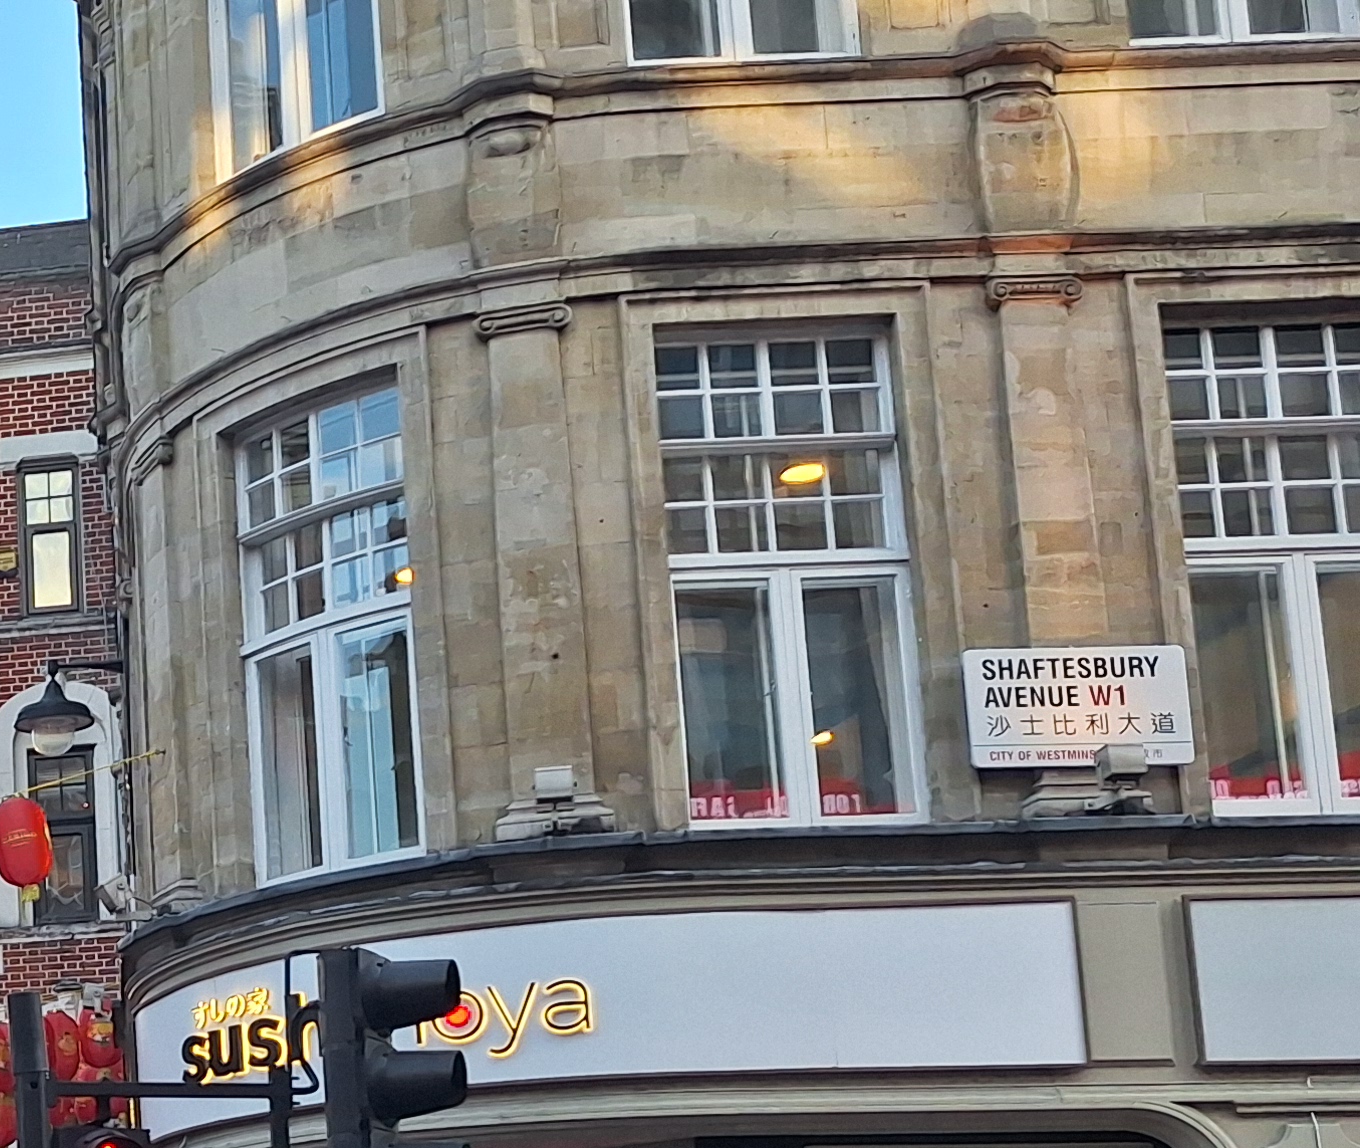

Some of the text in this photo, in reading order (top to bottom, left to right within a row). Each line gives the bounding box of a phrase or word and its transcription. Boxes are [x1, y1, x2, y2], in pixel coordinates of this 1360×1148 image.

[981, 655, 1159, 681] SHAFTESBURY
[984, 684, 1127, 708] AVENUE W1
[986, 711, 1177, 738] 沙士比利大道
[989, 748, 1096, 761] CITY OF WESTMINS
